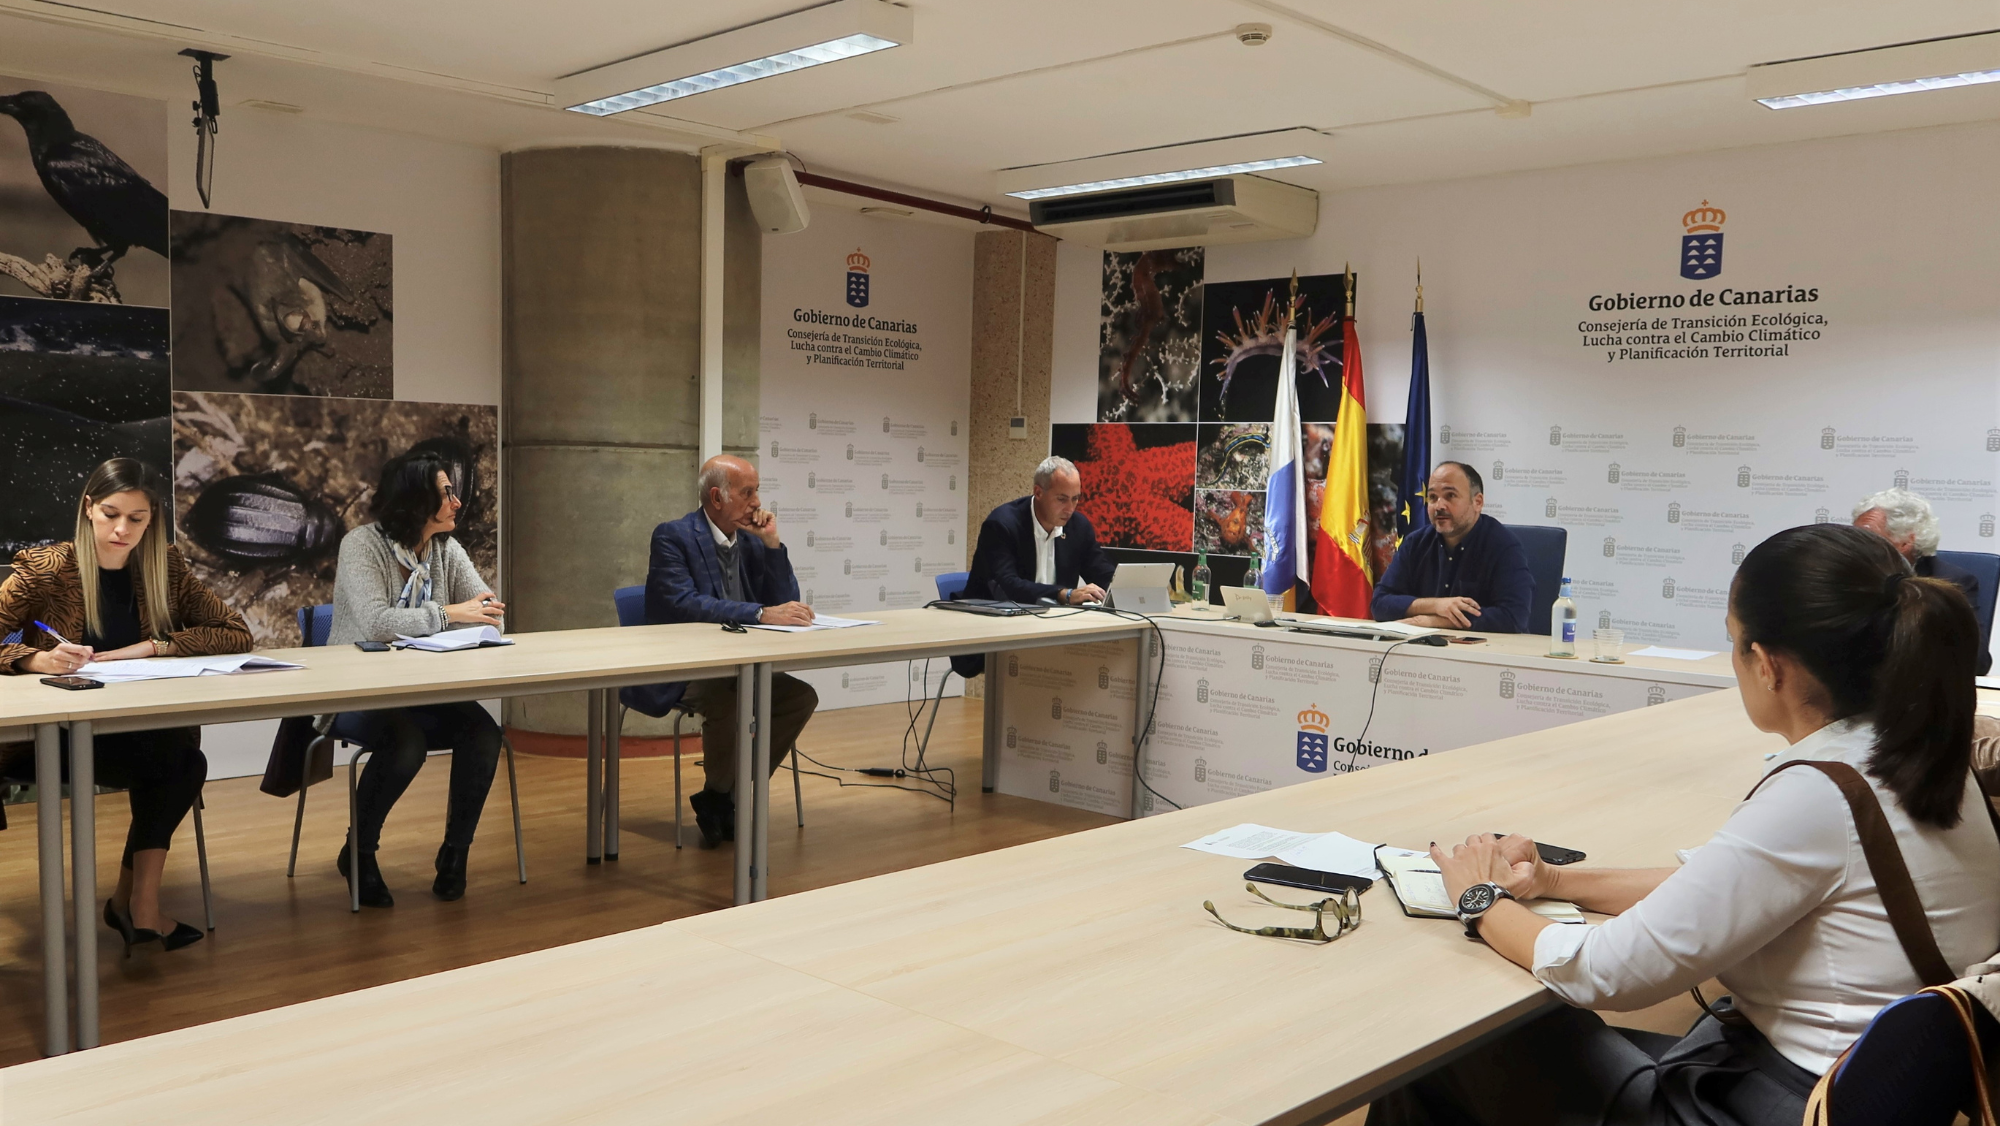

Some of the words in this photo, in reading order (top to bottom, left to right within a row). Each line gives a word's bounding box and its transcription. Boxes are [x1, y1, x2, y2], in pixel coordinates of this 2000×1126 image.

[1588, 292, 1686, 312] Gobierno
[1689, 289, 1715, 307] de
[1719, 284, 1819, 306] Canarias
[793, 308, 850, 327] Gobierno
[852, 314, 866, 328] de
[867, 317, 918, 334] Canarias
[1578, 318, 1648, 334] Consejería
[1651, 317, 1668, 330] de
[1671, 314, 1747, 329] Transición
[1751, 312, 1828, 328] Ecológica,
[787, 328, 830, 343] Consejería
[831, 332, 841, 343] de
[842, 334, 883, 346] Transición
[885, 338, 922, 351] Ecológica,
[1582, 334, 1622, 347] Lucha
[1626, 334, 1670, 345] contra
[1674, 331, 1686, 344] el
[1690, 330, 1744, 343] Cambio
[1748, 328, 1821, 341] Climático
[790, 341, 815, 351] Lucha
[817, 343, 842, 354] contra
[844, 345, 852, 354] el
[853, 346, 882, 358] Cambio
[884, 348, 919, 361] Climático
[1607, 351, 1616, 363] y
[1619, 346, 1708, 360] Planificación
[1713, 343, 1789, 358] Territorial
[806, 356, 811, 365] y
[814, 354, 864, 367] Planificación
[866, 358, 904, 370] Territorial
[1611, 618, 1640, 626] Gobierno
[1648, 621, 1675, 629] Canarias
[1194, 646, 1221, 656] Canarias
[1265, 655, 1296, 665] Gobierno
[1304, 660, 1334, 669] Canarias
[1384, 668, 1417, 678] Gobierno
[1418, 671, 1426, 679] de
[1427, 673, 1461, 683] Canarias
[1210, 689, 1238, 698] Gobierno
[1239, 692, 1246, 700] de
[1247, 693, 1275, 704] Canarias
[1516, 682, 1554, 693] Gobierno
[1555, 686, 1565, 694] de
[1566, 687, 1604, 699] Canarias
[1157, 721, 1184, 731] Gobierno
[1192, 726, 1219, 736] Canarias
[1333, 737, 1415, 761] Gobierno
[1207, 768, 1236, 778] Gobierno
[1237, 772, 1244, 780] de
[1244, 774, 1272, 785] Canarias
